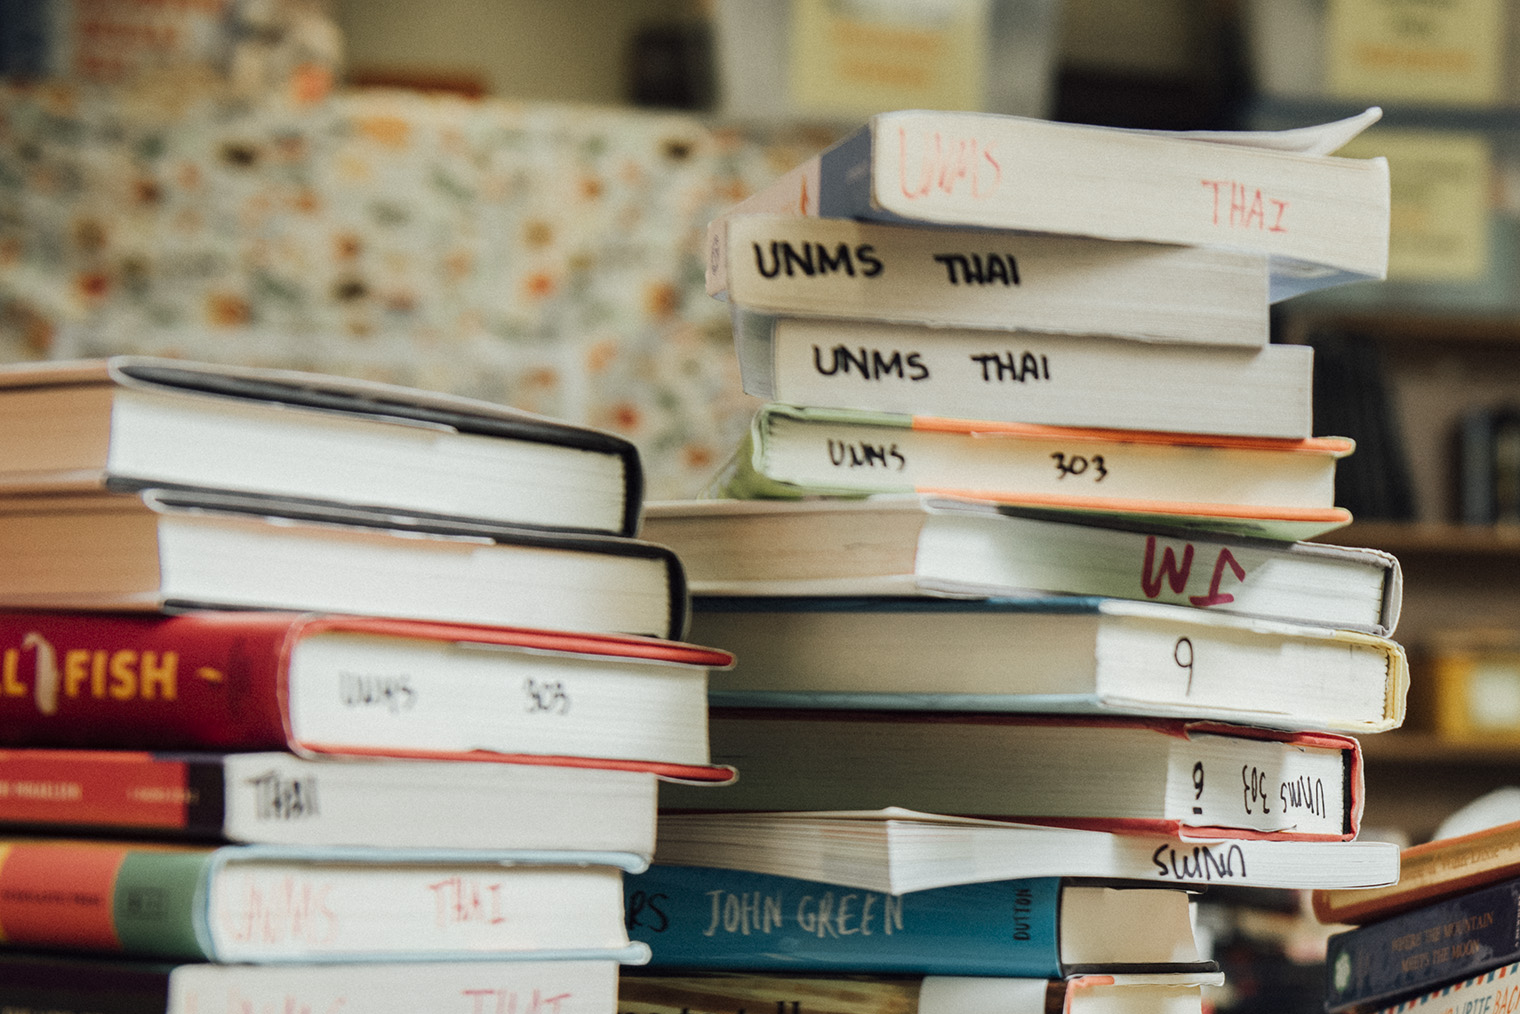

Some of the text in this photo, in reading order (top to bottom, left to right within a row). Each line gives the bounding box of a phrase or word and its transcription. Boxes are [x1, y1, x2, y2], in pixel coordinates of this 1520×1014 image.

[1201, 180, 1288, 233] THAI
[753, 240, 884, 280] UNMS
[934, 253, 1020, 287] THAI
[813, 344, 1050, 383] UNMS THAI
[1050, 452, 1107, 482] 303
[65, 649, 181, 701] FISH
[1241, 763, 1270, 815] 303
[703, 889, 784, 938] JOHN
[797, 890, 905, 939] GREEN
[1013, 888, 1033, 942] DUTTON
